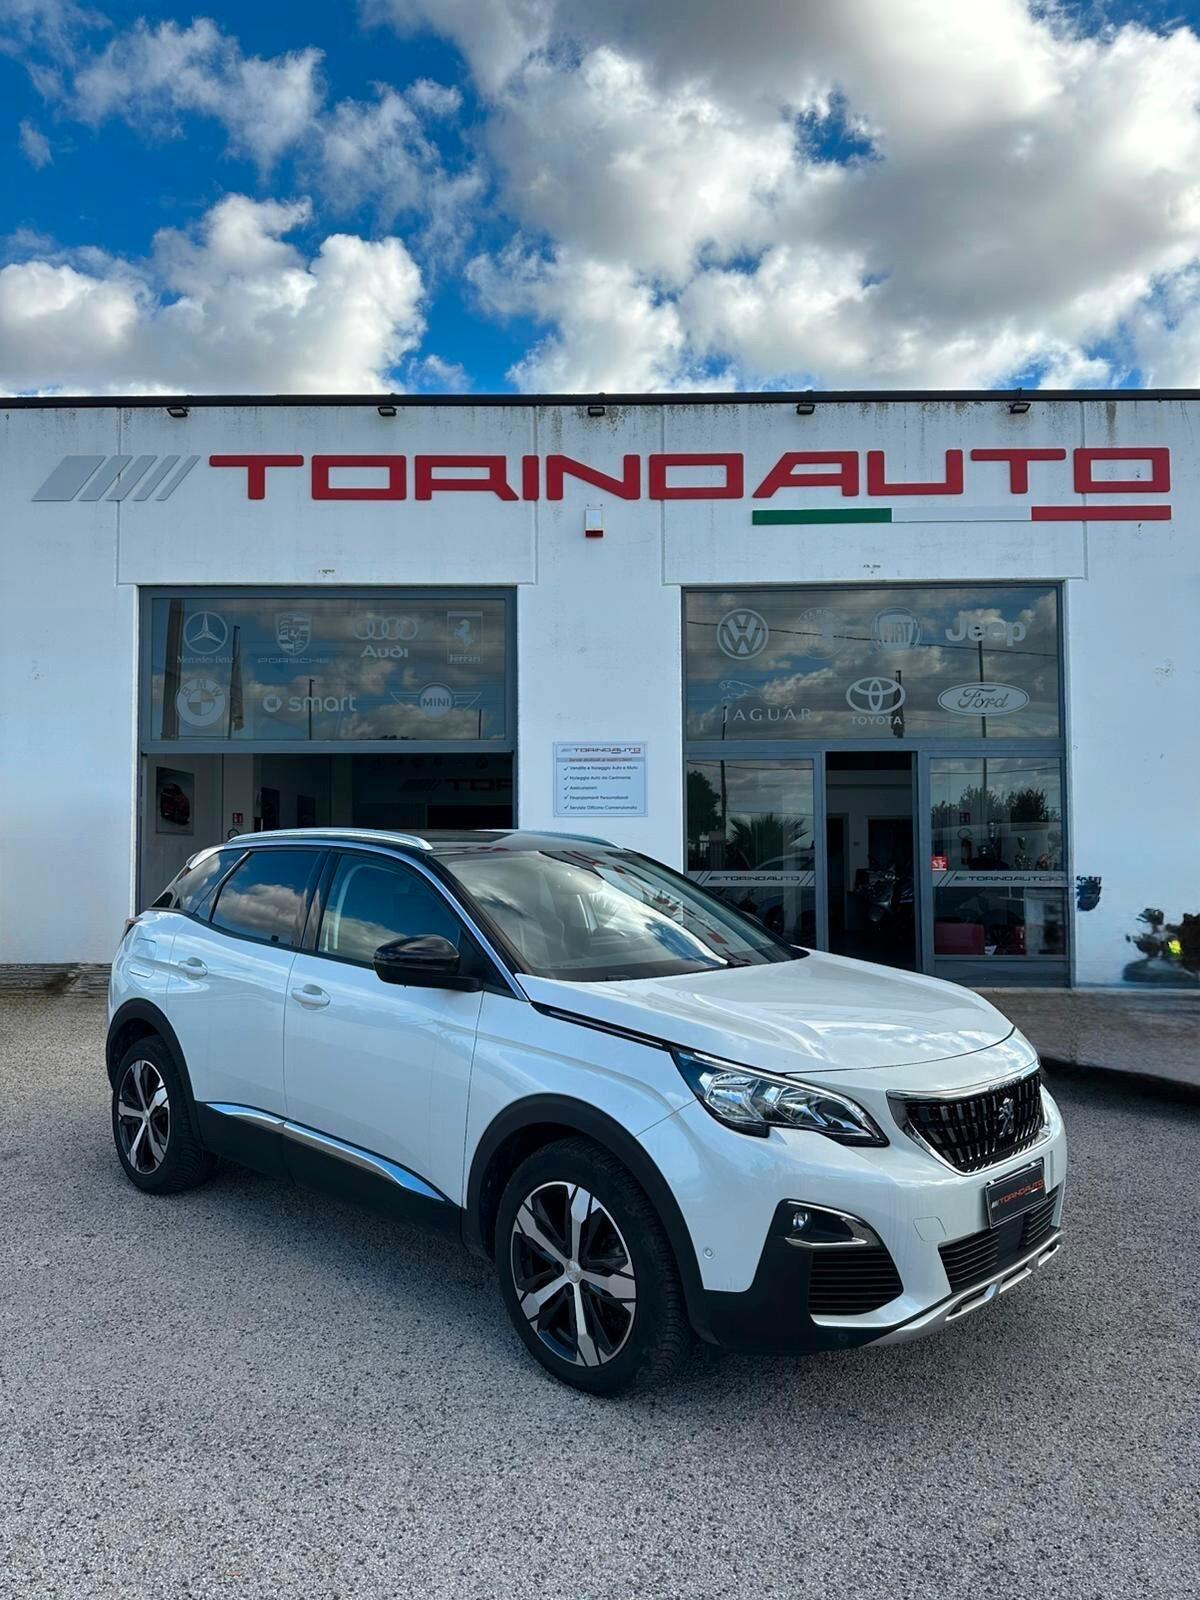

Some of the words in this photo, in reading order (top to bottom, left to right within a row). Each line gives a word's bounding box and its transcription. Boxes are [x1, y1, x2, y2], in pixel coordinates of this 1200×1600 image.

[208, 446, 1171, 501] TORINOAUTO
[945, 618, 1027, 647] Jeep
[360, 645, 409, 658] Audi
[449, 654, 481, 663] Ferrari
[288, 694, 357, 712] smart
[422, 697, 451, 709] MINI
[957, 687, 1010, 709] Ford
[722, 706, 813, 723] JAGUAR
[851, 716, 903, 725] TOYOTA
[1000, 1179, 1044, 1204] TORINOAUTO
